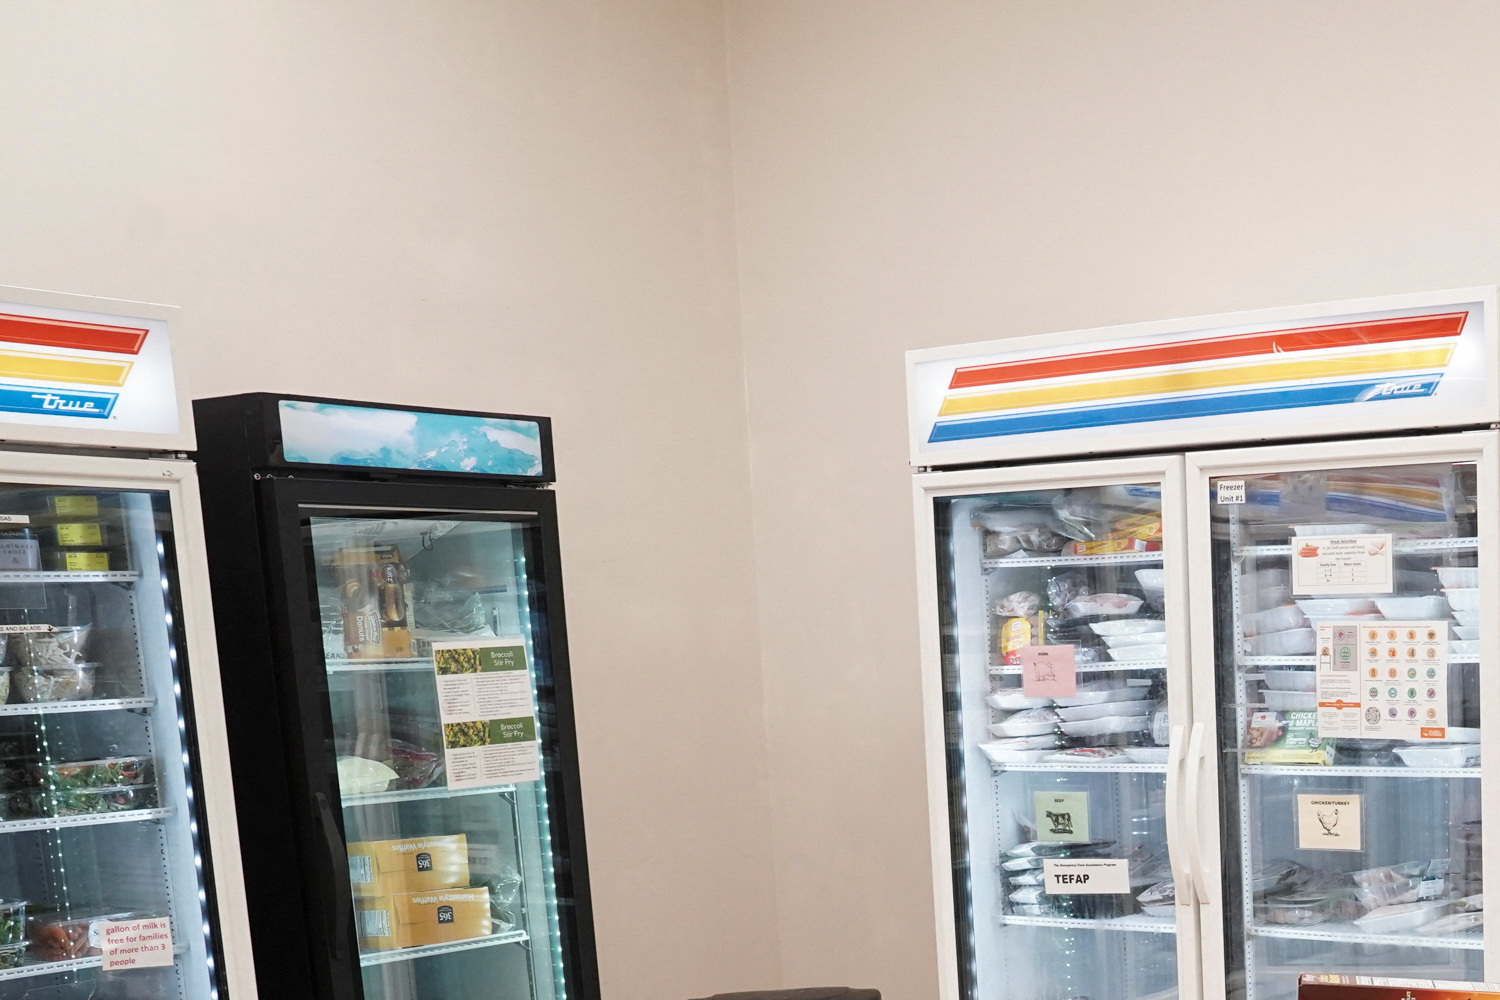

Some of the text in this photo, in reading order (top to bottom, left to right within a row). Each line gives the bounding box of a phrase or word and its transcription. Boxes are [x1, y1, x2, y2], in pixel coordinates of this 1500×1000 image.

[31, 394, 101, 412] true
[500, 722, 523, 730] Broccoli
[392, 843, 416, 852] Waffles
[418, 858, 431, 868] 365
[1054, 874, 1089, 884] TEFAP
[412, 894, 474, 905] Homestyle Waffles
[439, 911, 452, 921] 365
[106, 926, 130, 935] gallon
[139, 933, 168, 942] families
[110, 958, 136, 967] people
